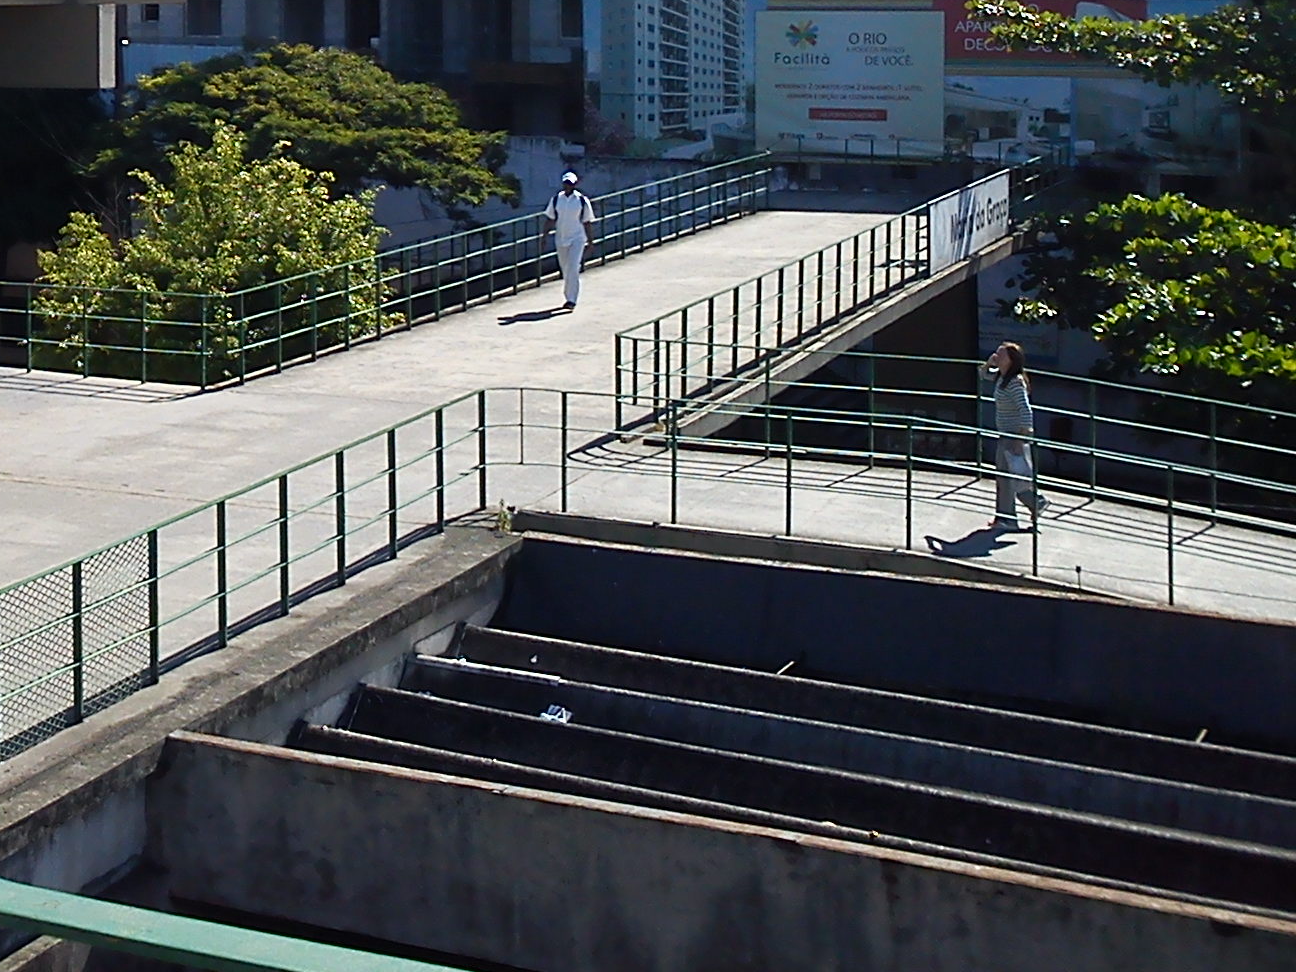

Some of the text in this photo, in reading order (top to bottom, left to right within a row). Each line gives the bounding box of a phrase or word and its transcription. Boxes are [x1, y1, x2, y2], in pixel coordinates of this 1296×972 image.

[849, 32, 887, 45] O RIO
[865, 55, 879, 66] DE
